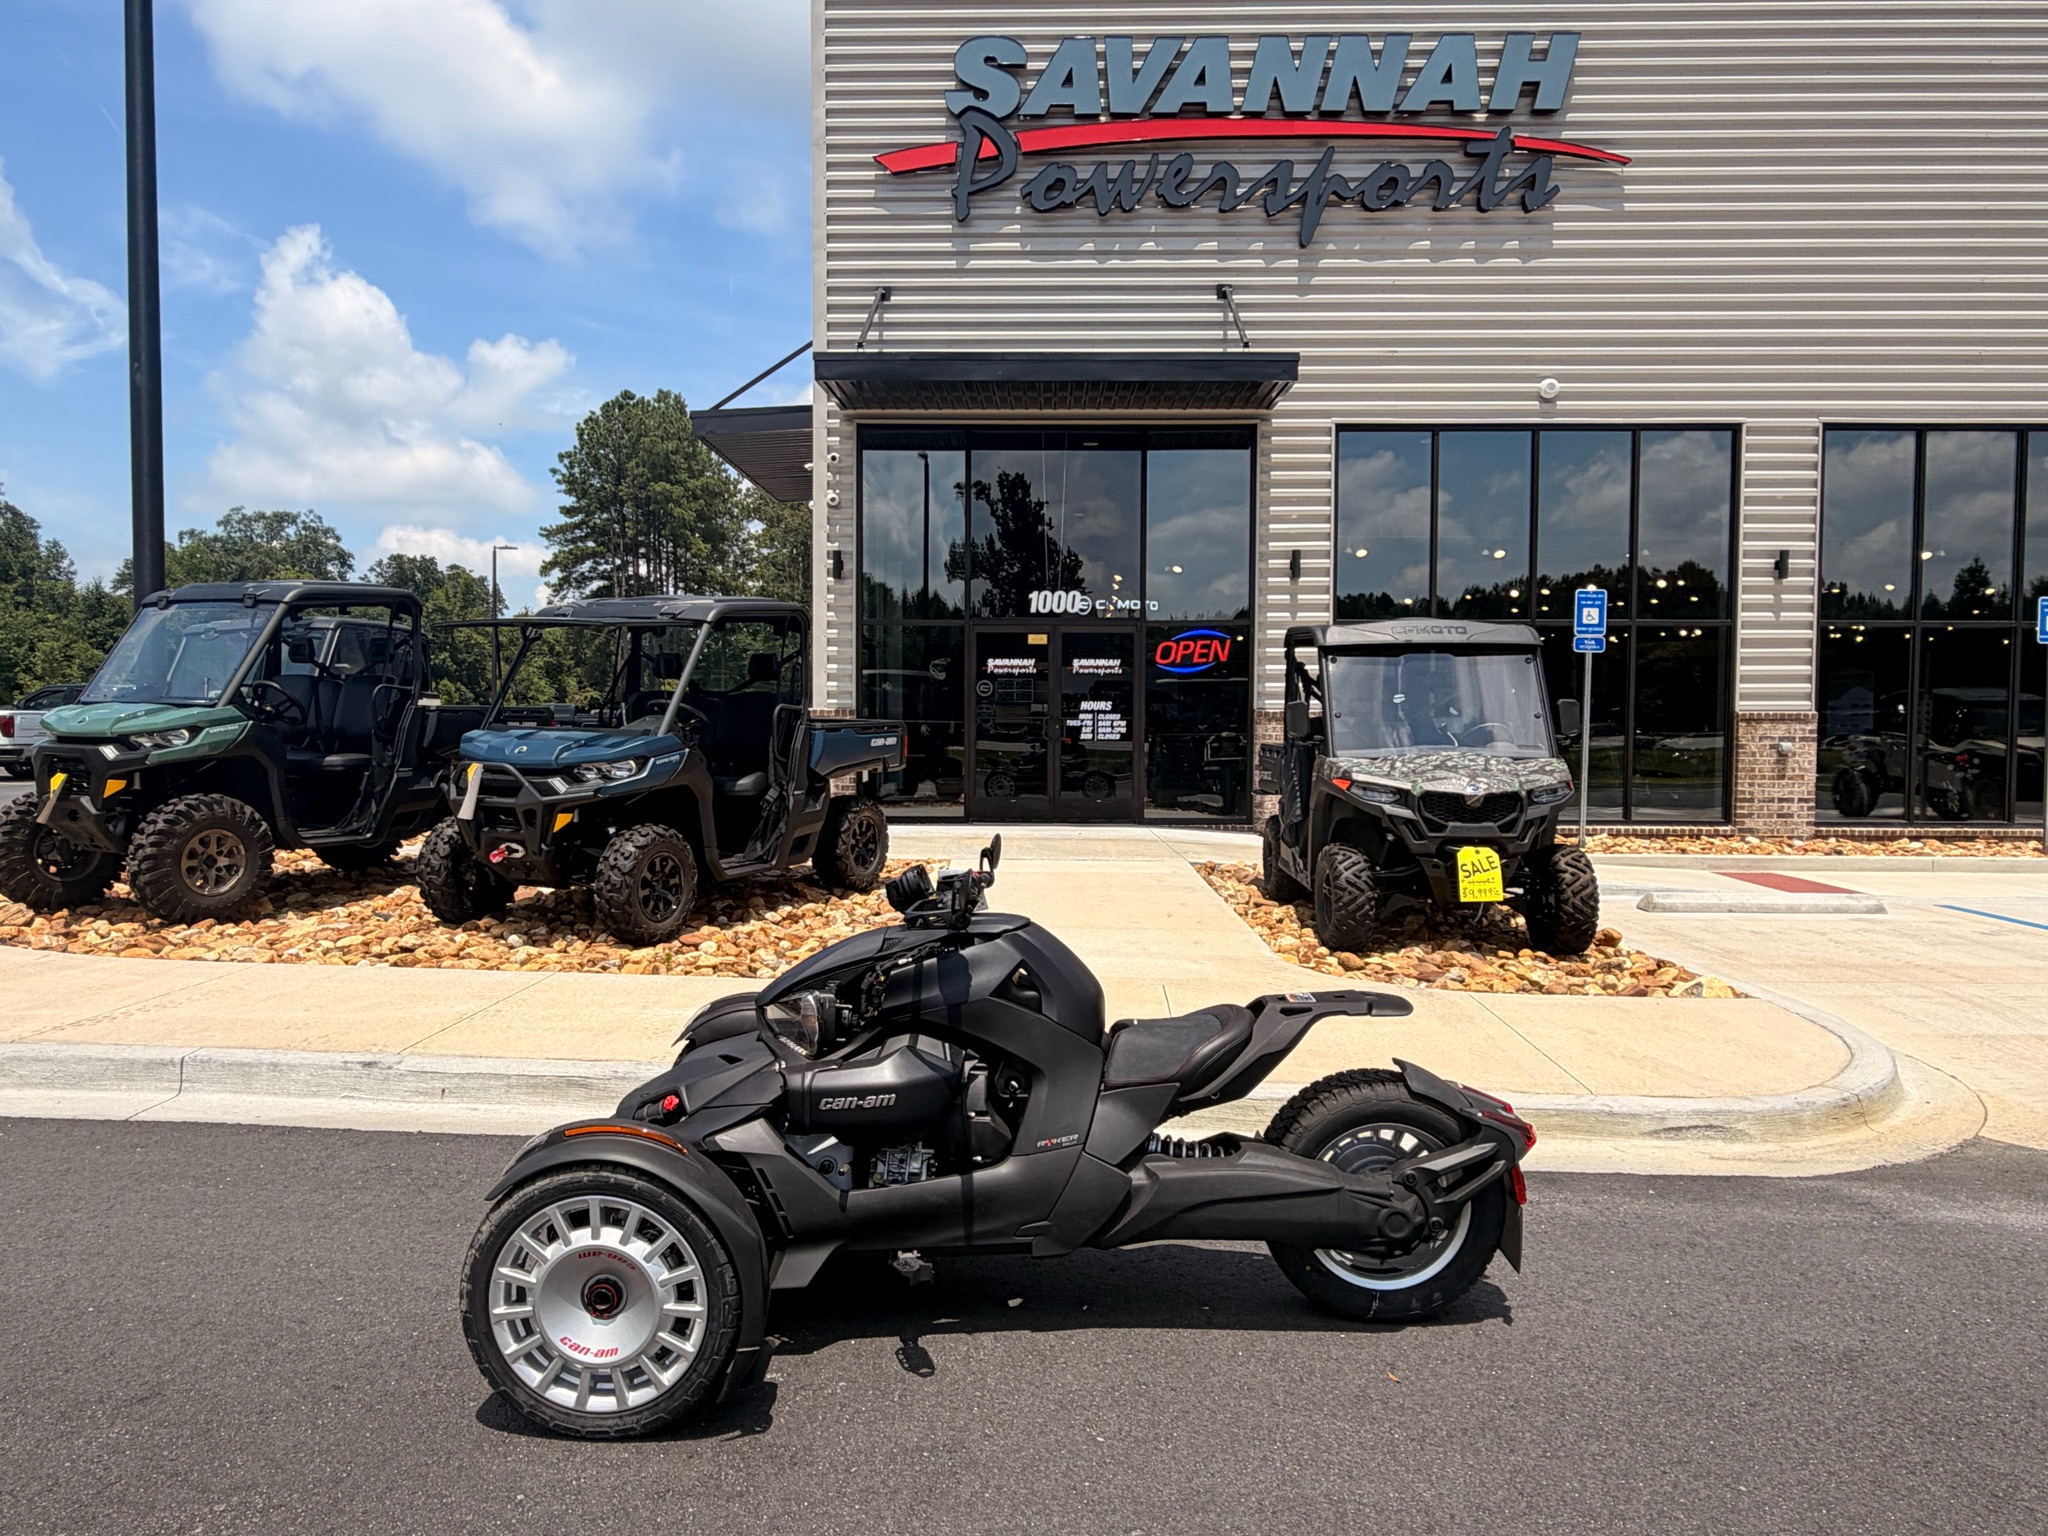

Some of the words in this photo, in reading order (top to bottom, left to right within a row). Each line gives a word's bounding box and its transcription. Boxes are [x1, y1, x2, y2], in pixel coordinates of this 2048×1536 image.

[944, 32, 1582, 119] SAVANNAH
[951, 107, 1561, 249] Powersports
[1028, 590, 1081, 614] 1000
[1155, 639, 1232, 664] OPEN
[986, 658, 1036, 667] SAVANNAH
[986, 665, 1037, 676] Powersports
[1072, 658, 1121, 667] SAVANNAH
[1072, 665, 1122, 676] Powersports
[1080, 700, 1113, 711] HOURS
[1460, 855, 1499, 879] SALE
[818, 1093, 897, 1111] can-am
[578, 1251, 637, 1270] can-am
[559, 1336, 619, 1358] can-am
